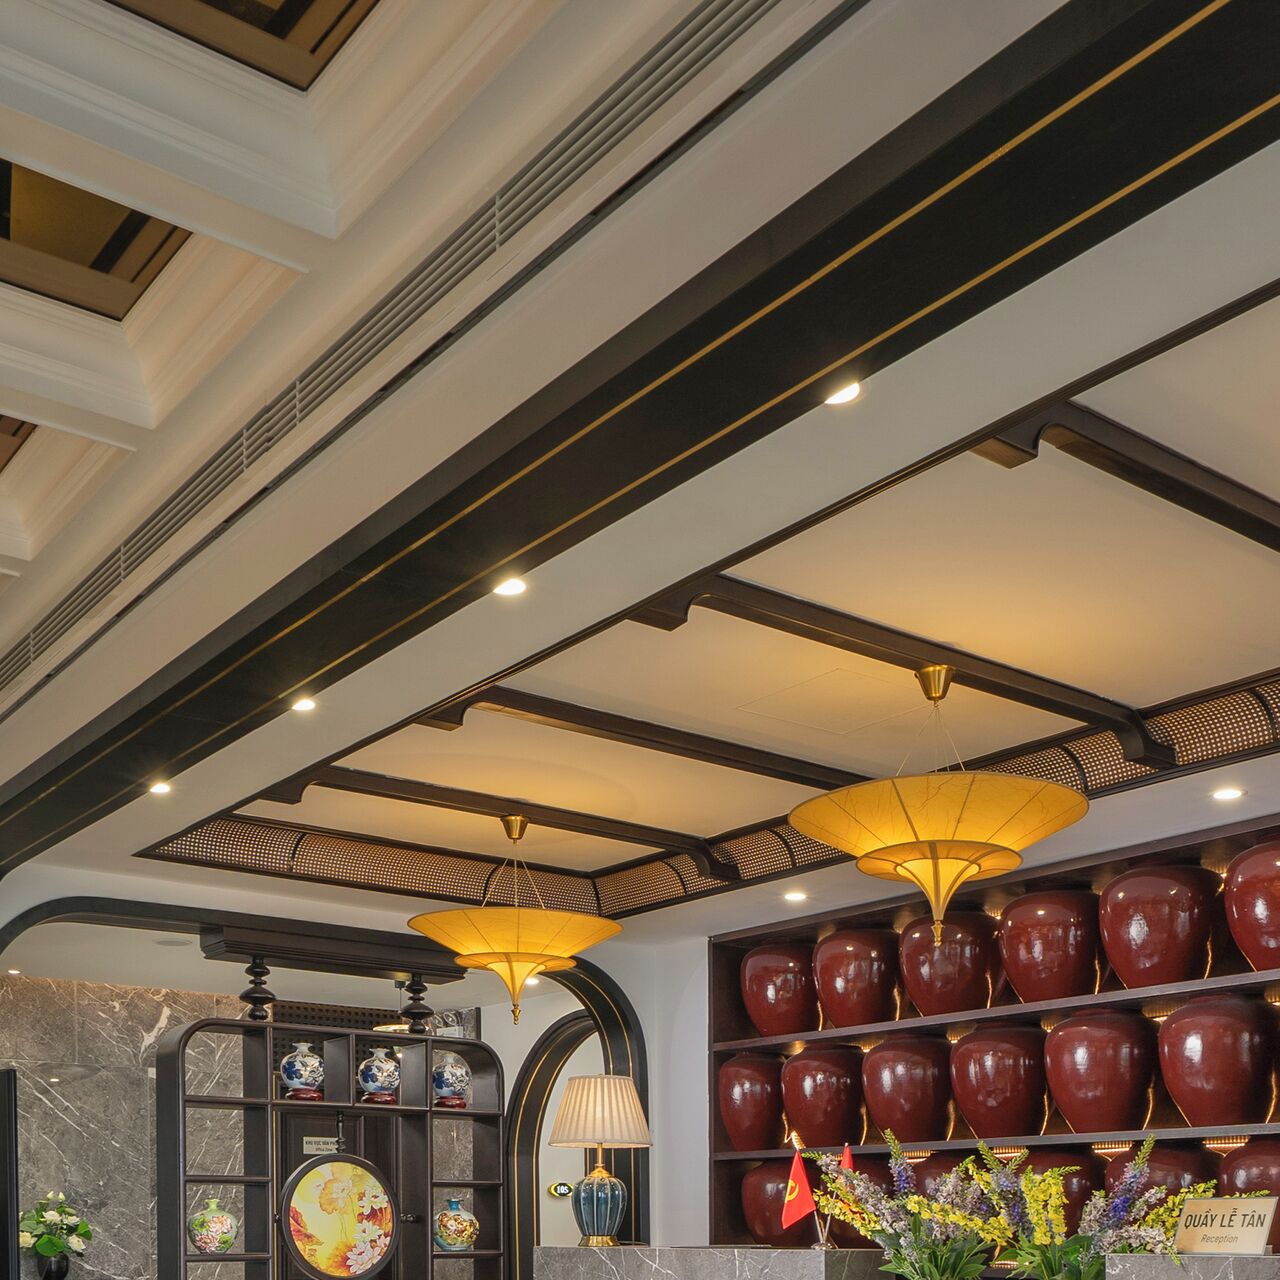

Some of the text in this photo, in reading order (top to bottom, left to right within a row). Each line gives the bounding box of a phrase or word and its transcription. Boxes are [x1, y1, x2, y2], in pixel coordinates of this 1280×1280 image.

[556, 1185, 569, 1194] 105
[1184, 1207, 1267, 1230] QUẦY LỄ TÂN
[1200, 1234, 1239, 1244] Reception
